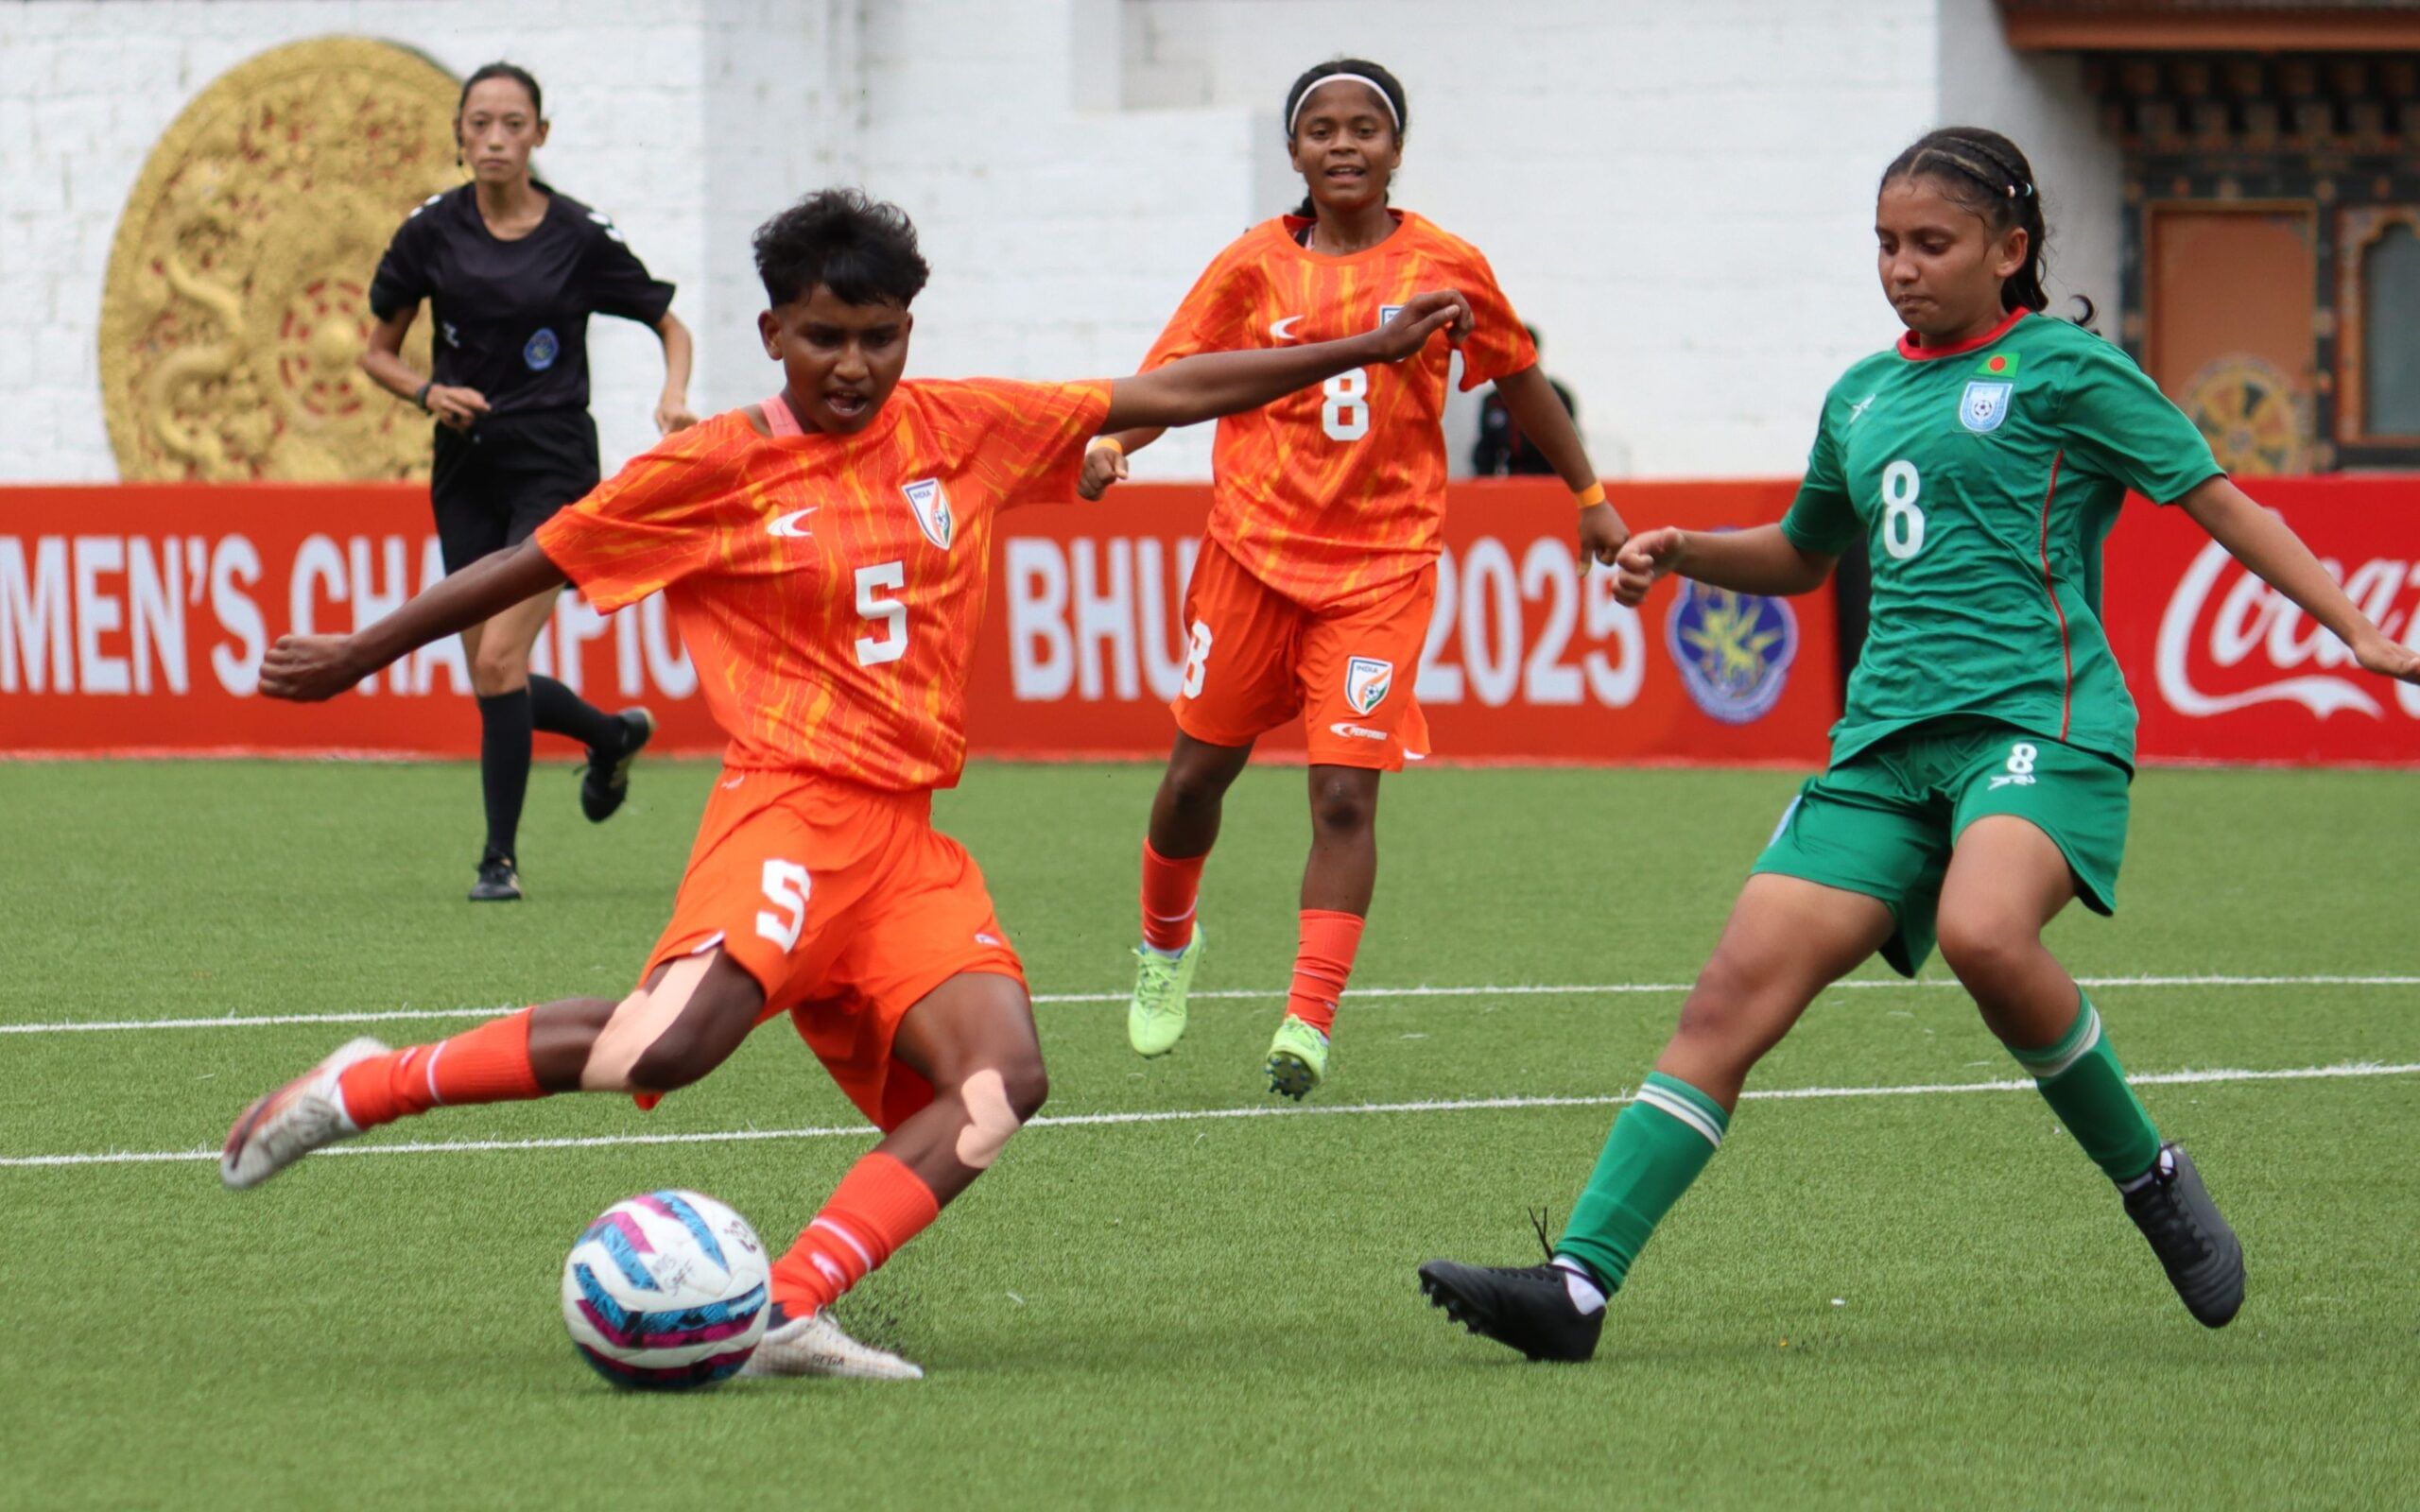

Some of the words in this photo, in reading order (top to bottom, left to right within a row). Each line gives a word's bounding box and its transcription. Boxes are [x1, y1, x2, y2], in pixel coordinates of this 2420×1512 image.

[1322, 367, 1370, 442] 8
[1882, 459, 1925, 559] 8
[0, 535, 268, 696] MEN'S
[1412, 538, 1645, 707] 2025
[854, 560, 908, 667] 5
[1184, 619, 1213, 699] 8
[2006, 742, 2038, 775] 8
[755, 857, 812, 954] 5
